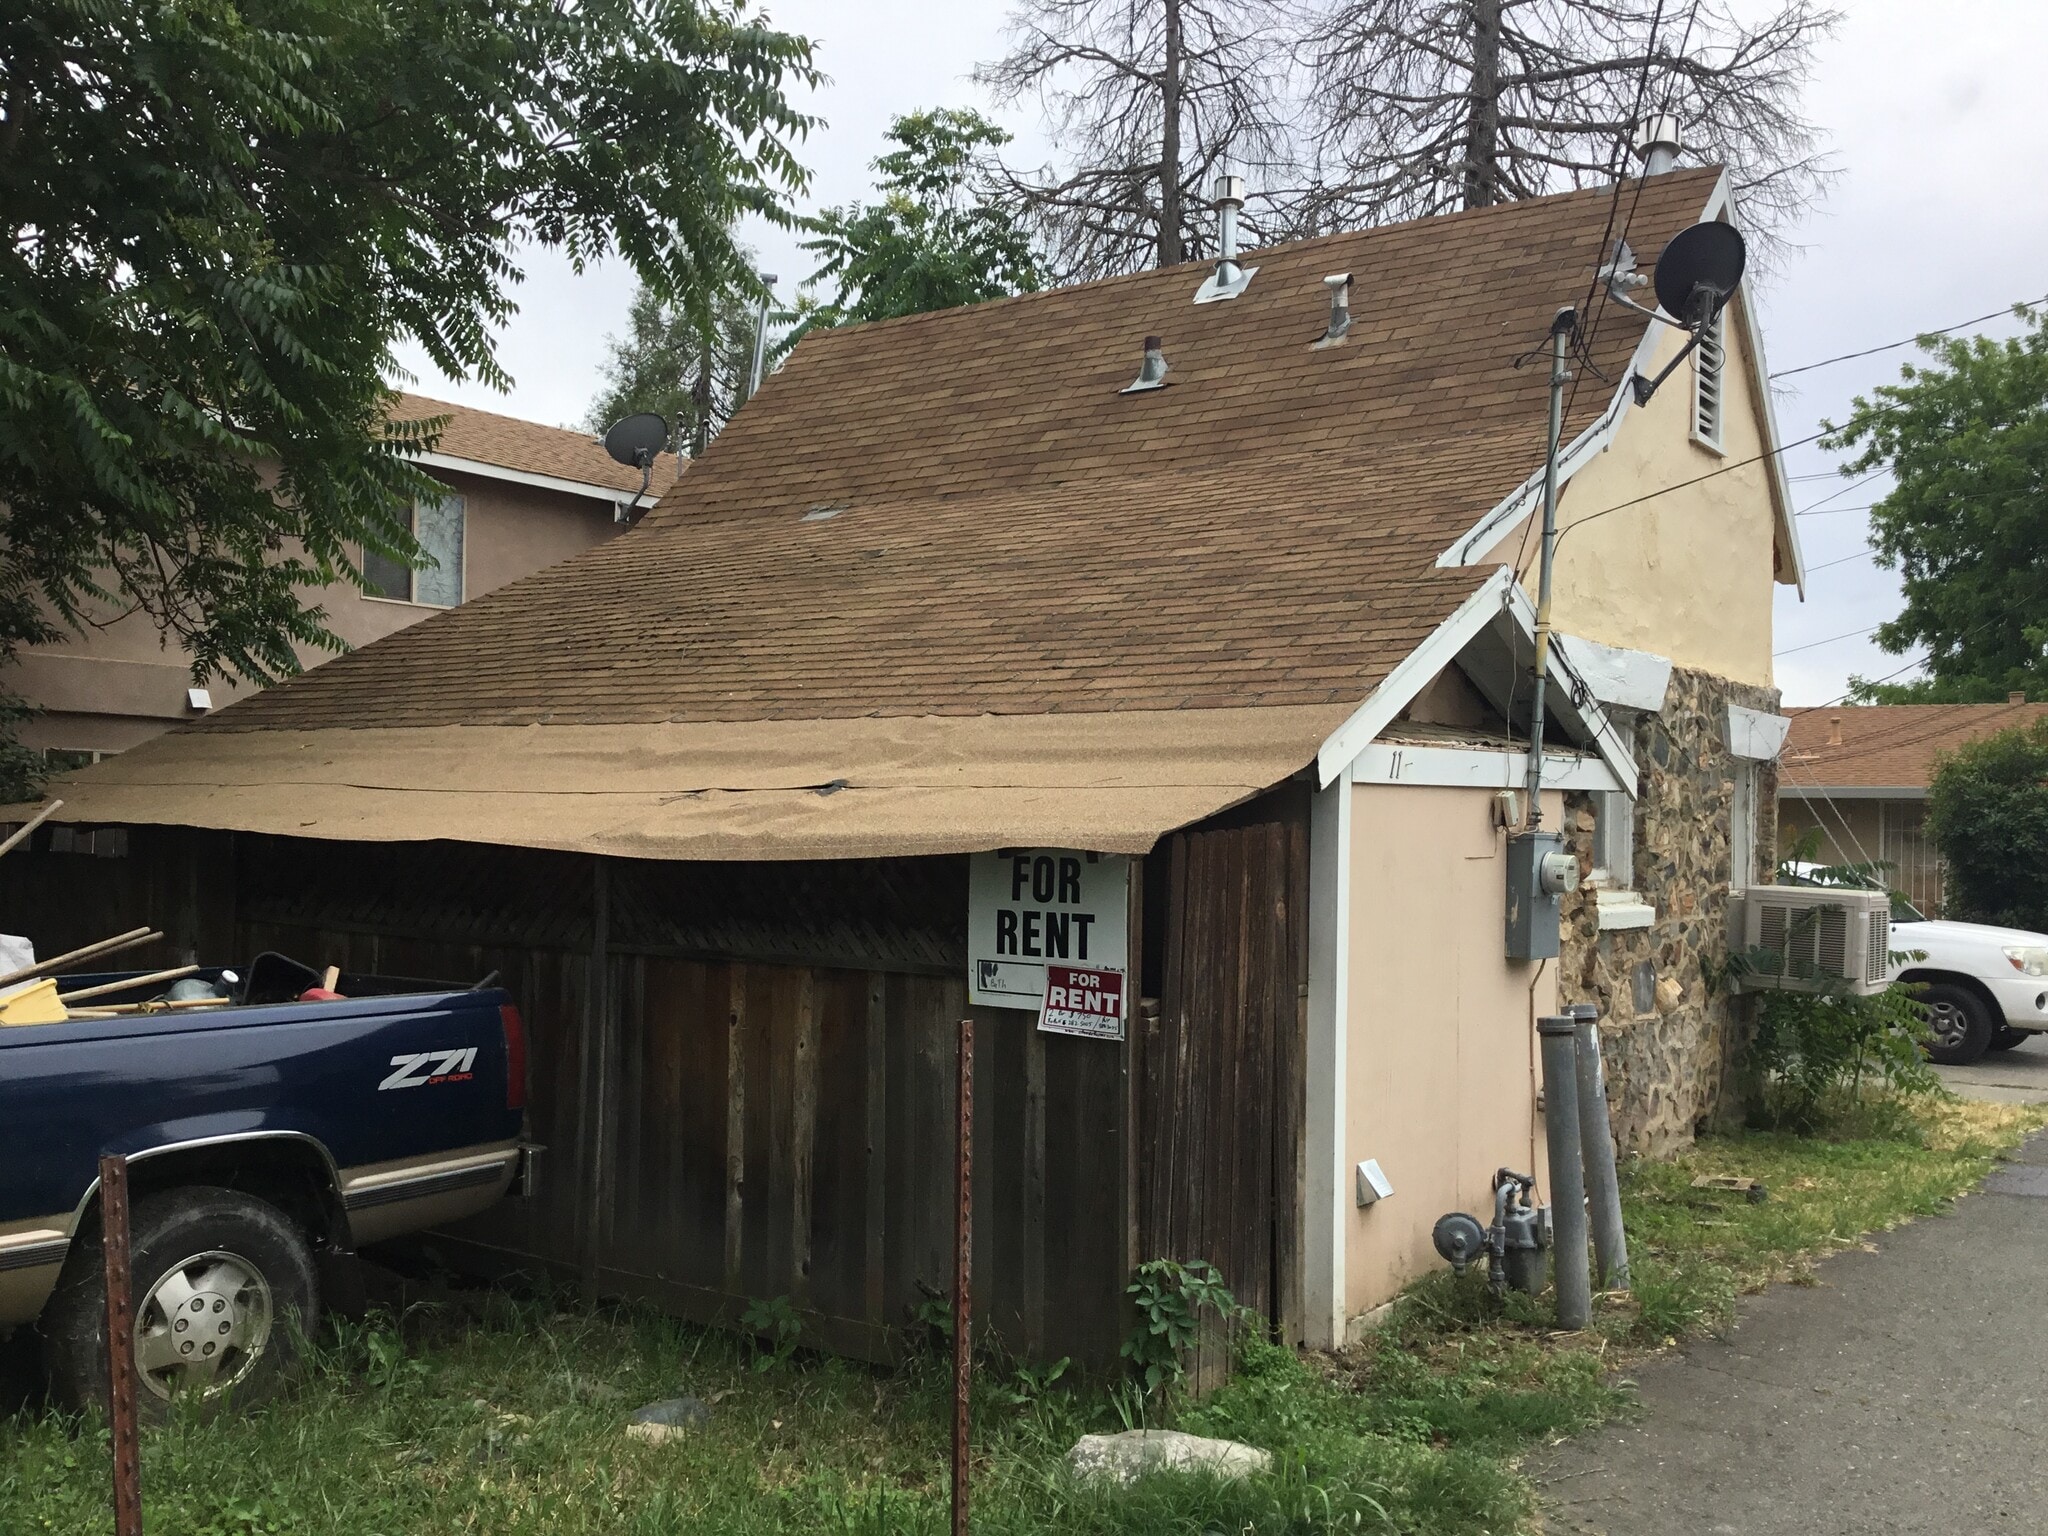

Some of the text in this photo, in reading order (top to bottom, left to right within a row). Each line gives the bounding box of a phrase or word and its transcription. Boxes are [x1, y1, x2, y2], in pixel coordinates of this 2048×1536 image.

[1011, 855, 1081, 904] FOR
[996, 909, 1096, 960] RENT
[1069, 972, 1100, 988] FOR
[1049, 986, 1119, 1014] RENT
[378, 1047, 478, 1091] Z71
[428, 1072, 473, 1085] OFF ROAD
